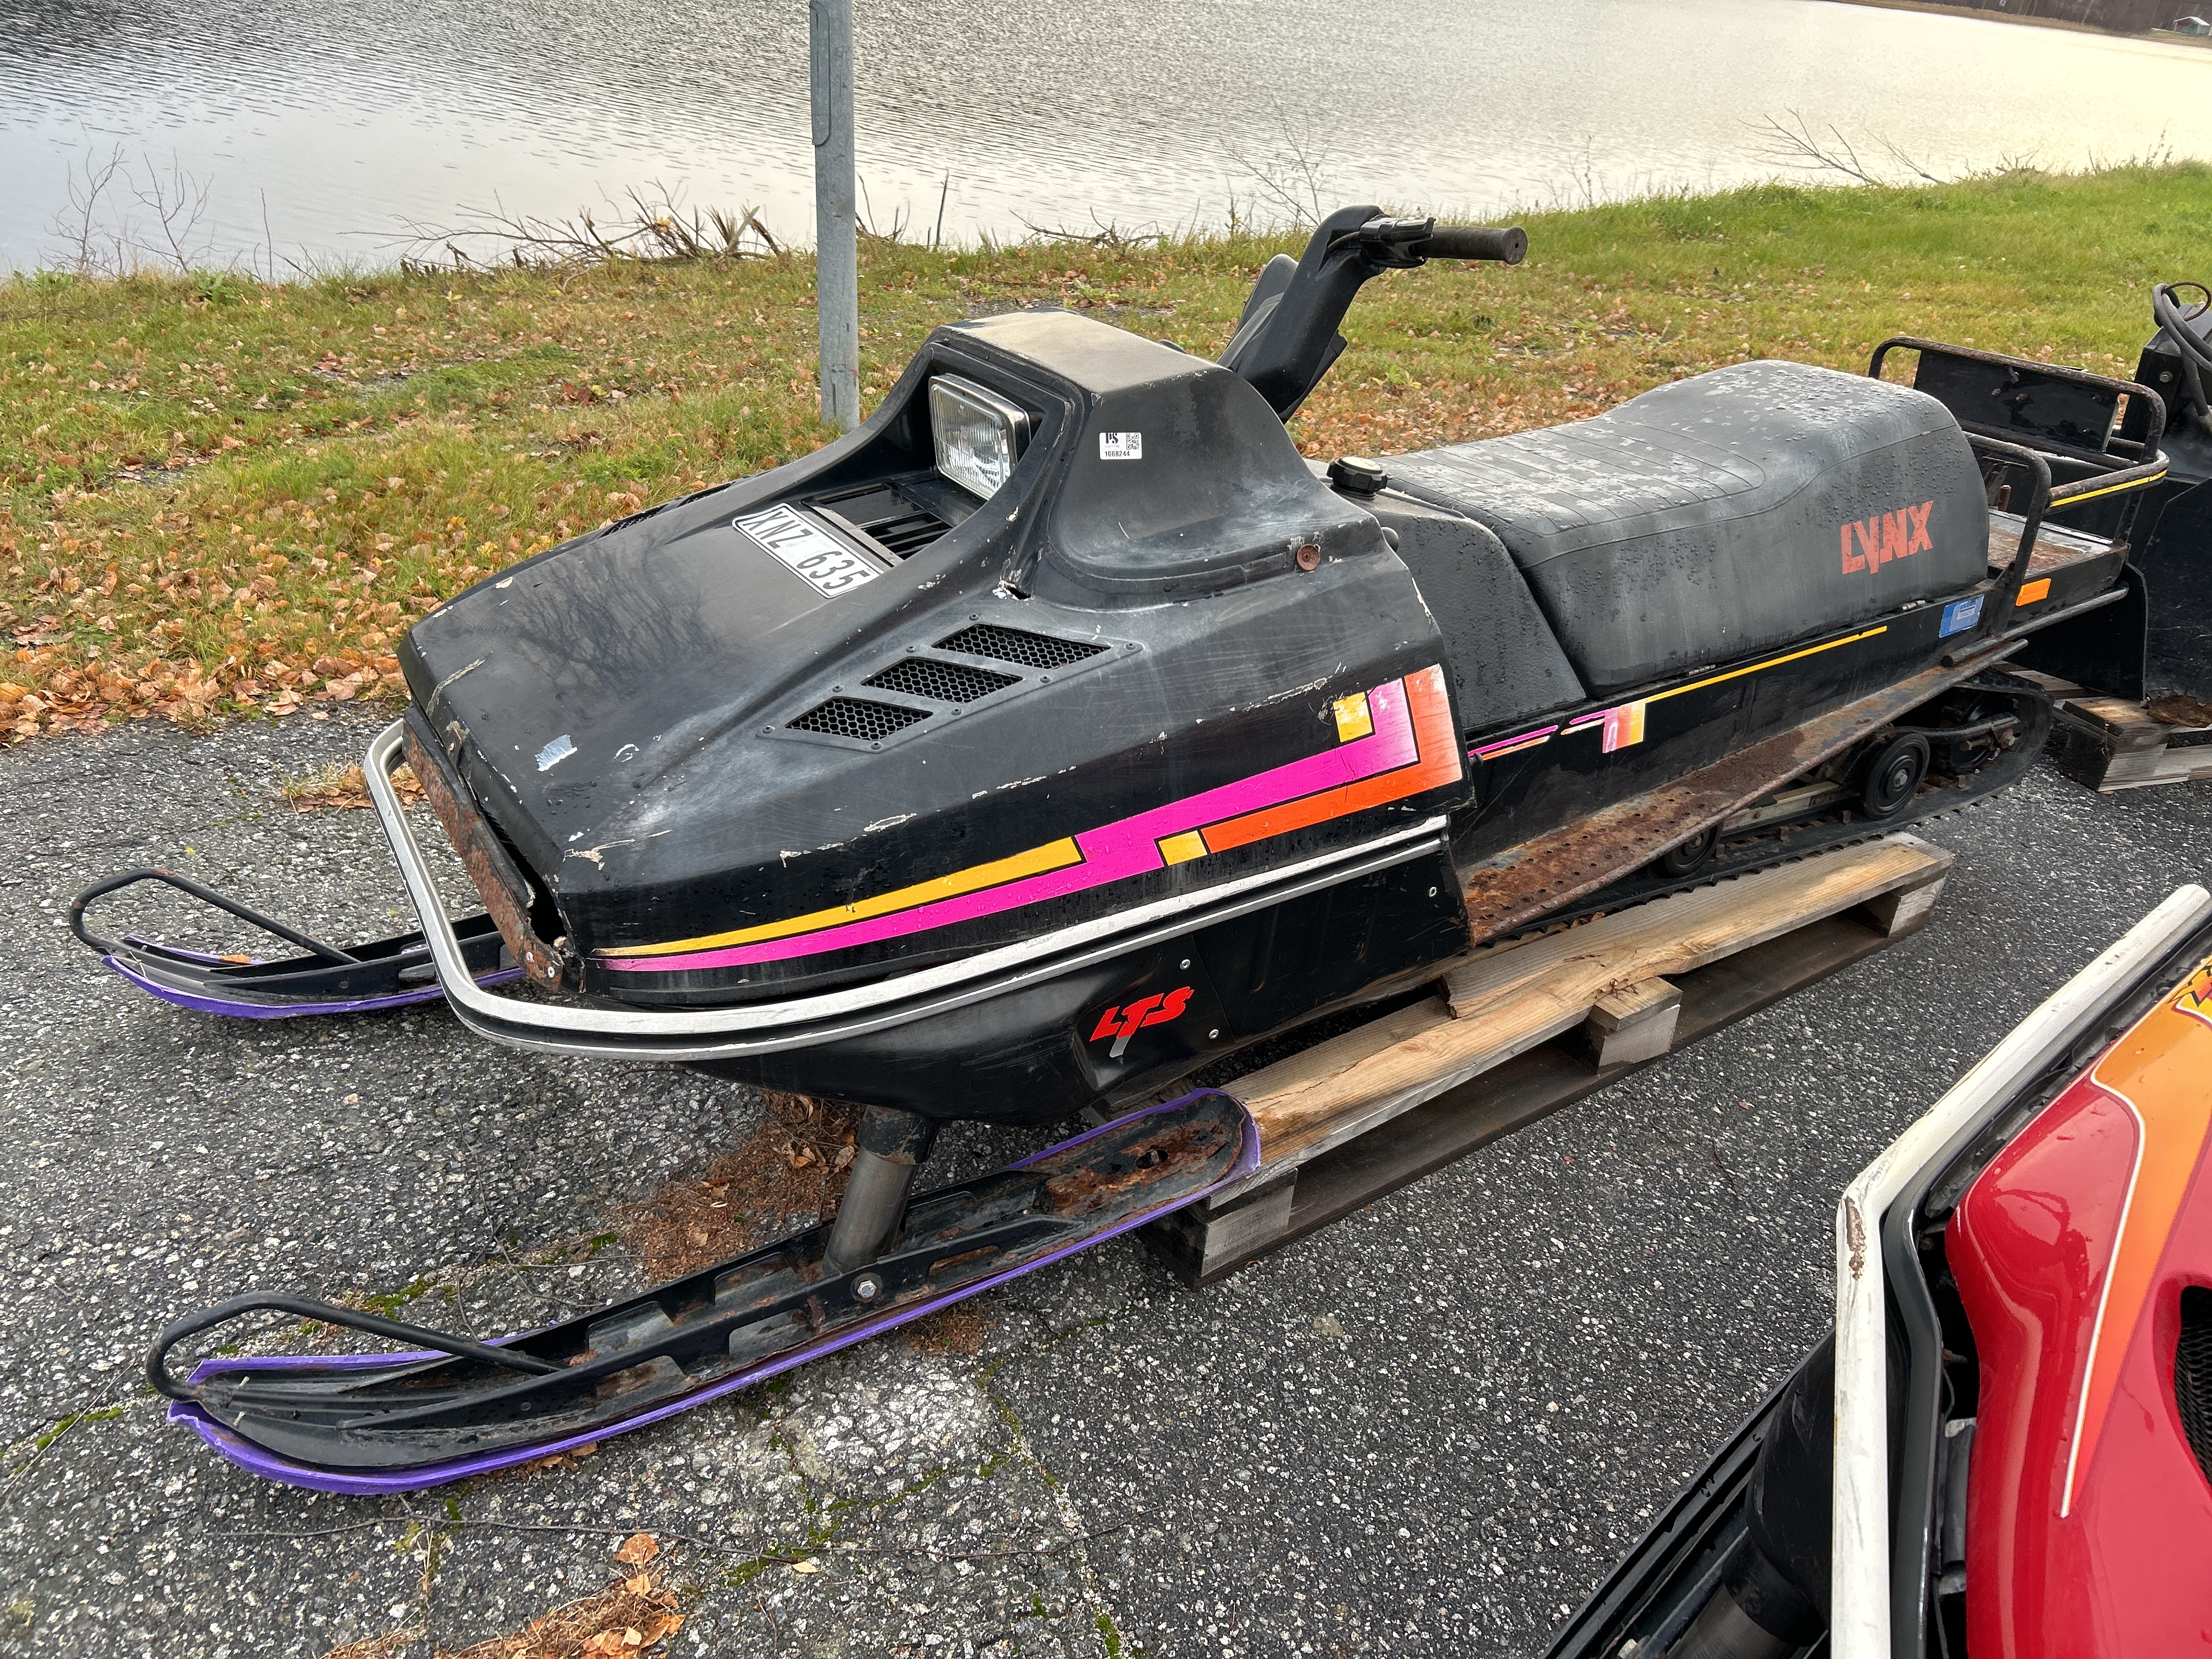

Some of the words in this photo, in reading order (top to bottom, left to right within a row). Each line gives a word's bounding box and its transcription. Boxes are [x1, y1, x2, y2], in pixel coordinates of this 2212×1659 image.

[742, 511, 814, 549] XNZ
[796, 551, 871, 590] 635
[1841, 500, 1934, 574] LYNX
[1090, 986, 1195, 1058] LTS
